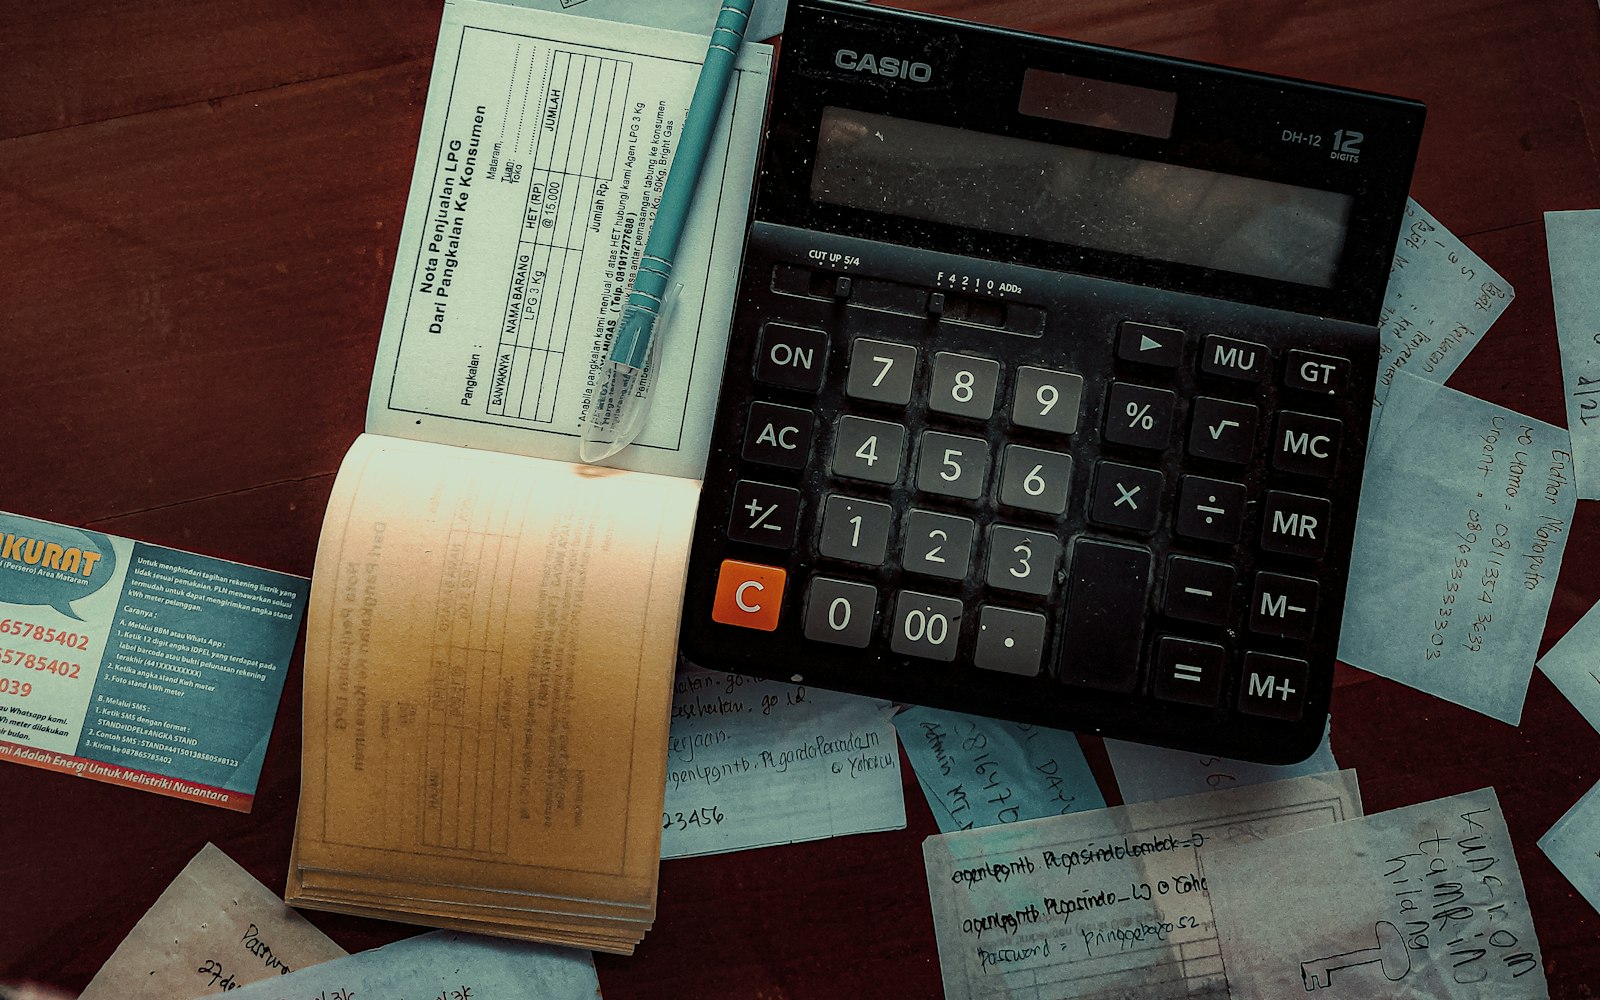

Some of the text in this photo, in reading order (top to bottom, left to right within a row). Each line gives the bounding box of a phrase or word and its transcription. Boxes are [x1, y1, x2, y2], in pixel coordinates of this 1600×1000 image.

[836, 49, 932, 82] CASIO
[544, 89, 560, 131] JUMLAH
[633, 102, 645, 114] Kg
[651, 100, 665, 144] konsumen
[628, 124, 639, 143] LPG
[663, 120, 673, 137] Gas
[1282, 130, 1321, 147] DH-12
[1332, 130, 1364, 155] 12
[624, 145, 635, 168] Agen
[648, 146, 658, 156] ke
[658, 139, 670, 165] Bright
[1331, 151, 1360, 163] DIGITS
[510, 164, 522, 184] Toko
[619, 168, 631, 189] kami
[643, 158, 657, 188] tabung
[525, 182, 544, 228] HET (RP)
[544, 181, 560, 215] 15.000
[419, 139, 461, 293] Nota Penjualan LPG
[428, 105, 485, 333] Dari Pangkalan Ke Konsumen
[589, 199, 604, 232] Jumlah
[634, 190, 651, 246] pemasangan
[609, 227, 621, 247] HET
[607, 249, 617, 268] atas
[630, 247, 640, 270] antar
[809, 250, 860, 266] CUT UP 5/4
[604, 269, 613, 278] di
[938, 272, 943, 280] F
[949, 274, 956, 283] 4
[962, 277, 968, 285] 2
[975, 279, 979, 287] 1
[987, 280, 994, 290] 0
[505, 255, 529, 333] NAMA BARANG
[523, 297, 537, 320] LPG
[531, 270, 545, 284] Kg
[599, 280, 612, 314] menjual
[610, 285, 624, 306] Telp.
[593, 316, 605, 337] kami
[586, 340, 601, 386] pangkalan
[771, 344, 813, 369] ON
[1214, 345, 1255, 370] MU
[460, 353, 480, 406] Pangkalan
[491, 354, 510, 405] BANYAKNYA
[872, 357, 894, 387] 7
[1301, 362, 1336, 384] GT
[952, 371, 974, 402] 8
[1036, 385, 1059, 415] 9
[756, 424, 799, 449] AC
[1283, 430, 1330, 458] MC
[855, 436, 878, 466] 4
[940, 449, 963, 481] 5
[1023, 464, 1045, 496] 6
[850, 516, 862, 547] 1
[1272, 511, 1318, 539] MR
[0, 533, 101, 577] KURAT
[925, 529, 947, 562] 2
[3, 561, 88, 585] (Persero) Area Mataram
[1009, 544, 1032, 578] 3
[134, 568, 152, 577] tidak
[152, 572, 174, 581] sesuai
[213, 585, 228, 593] PLN
[227, 589, 271, 603] menawarkan
[271, 599, 292, 608] solusi
[137, 556, 296, 599] Untuk menghindari tagihan rekening listrik yang
[127, 589, 143, 598] kWh
[143, 594, 164, 603] meter
[131, 578, 292, 619] termudah untuk dapat mengirimkan angka stand
[736, 581, 764, 612] C
[123, 604, 153, 617] Caranya
[828, 597, 851, 630] 0
[127, 620, 153, 631] Melalui
[153, 626, 169, 635] BBM
[169, 631, 185, 639] atau
[186, 633, 206, 643] Whats
[207, 638, 222, 648] App
[904, 609, 948, 645] 00
[1249, 673, 1295, 701] M+
[8, 719, 68, 736] meter dilakukan
[9, 706, 67, 724] Whatsapp kami.
[7, 729, 30, 740] bulan.
[173, 735, 197, 745] STAND
[12, 747, 229, 803] Adalah Energi Untuk Melistriki Nusantara
